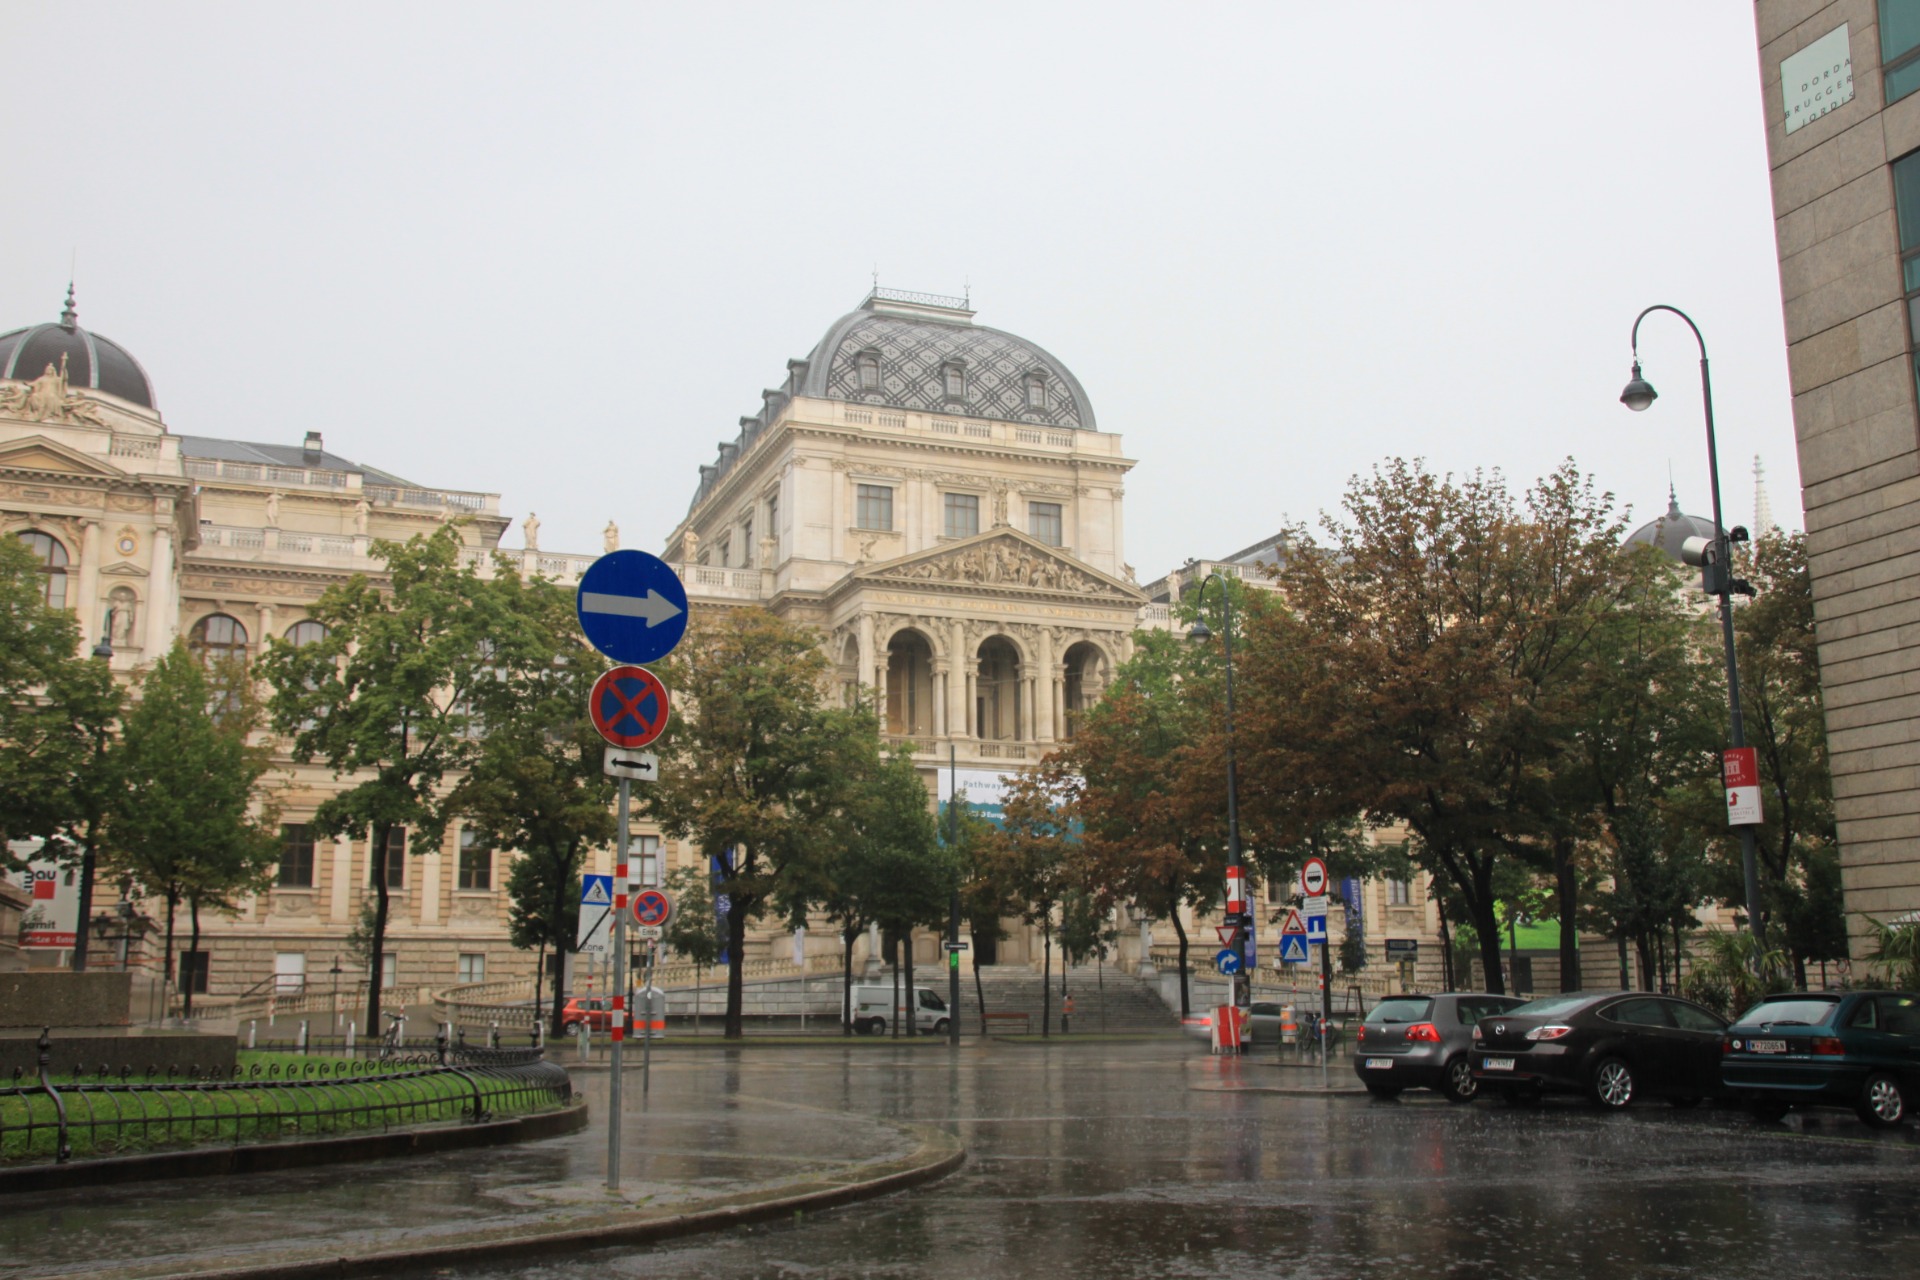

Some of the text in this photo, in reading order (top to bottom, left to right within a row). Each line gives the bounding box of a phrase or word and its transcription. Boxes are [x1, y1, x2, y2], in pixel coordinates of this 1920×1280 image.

[1801, 58, 1851, 93] DORDA
[1784, 75, 1853, 120] BRUGGER
[642, 928, 658, 936] Ende
